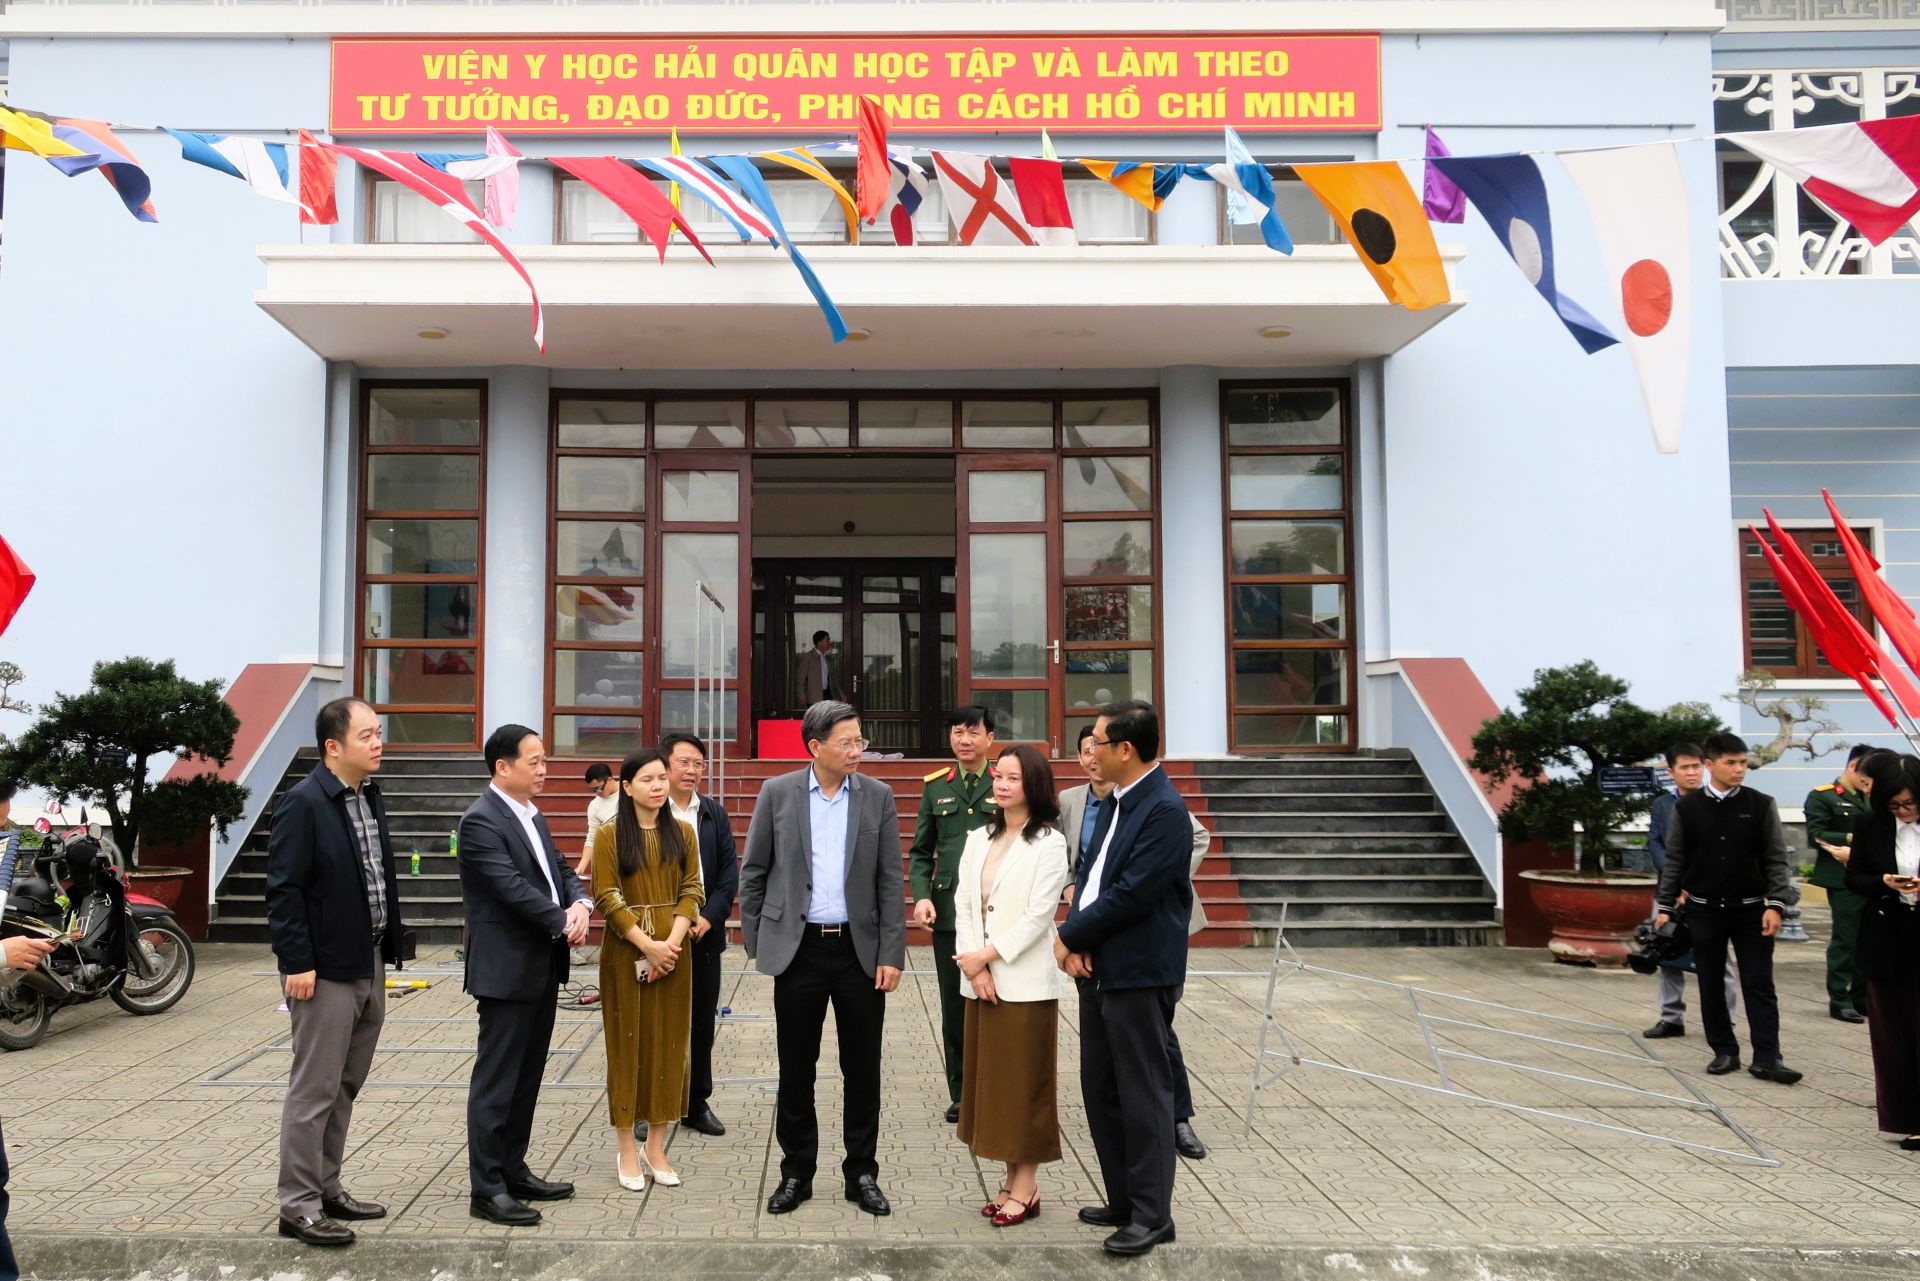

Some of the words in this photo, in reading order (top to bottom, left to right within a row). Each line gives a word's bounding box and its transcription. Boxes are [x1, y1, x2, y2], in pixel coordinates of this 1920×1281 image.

[422, 48, 508, 86] VIỆN
[523, 54, 547, 79] Y
[562, 53, 638, 85] HỌC
[654, 45, 717, 80] HẢI
[732, 47, 837, 83] QUÂN
[853, 52, 929, 84] HỌC
[944, 46, 1017, 84] TẬP
[1031, 46, 1082, 78] VÀ
[1097, 46, 1178, 78] LÀM
[1193, 50, 1290, 77] THEO
[356, 92, 412, 122] TƯ
[421, 86, 570, 124] TƯỞNG,
[585, 93, 671, 126] ĐẠO
[685, 87, 782, 123] ĐỨC,
[957, 87, 1069, 120] CÁCH
[1086, 84, 1141, 120] HỒ
[1157, 86, 1227, 119] CHÍ
[1244, 91, 1356, 119] MINH
